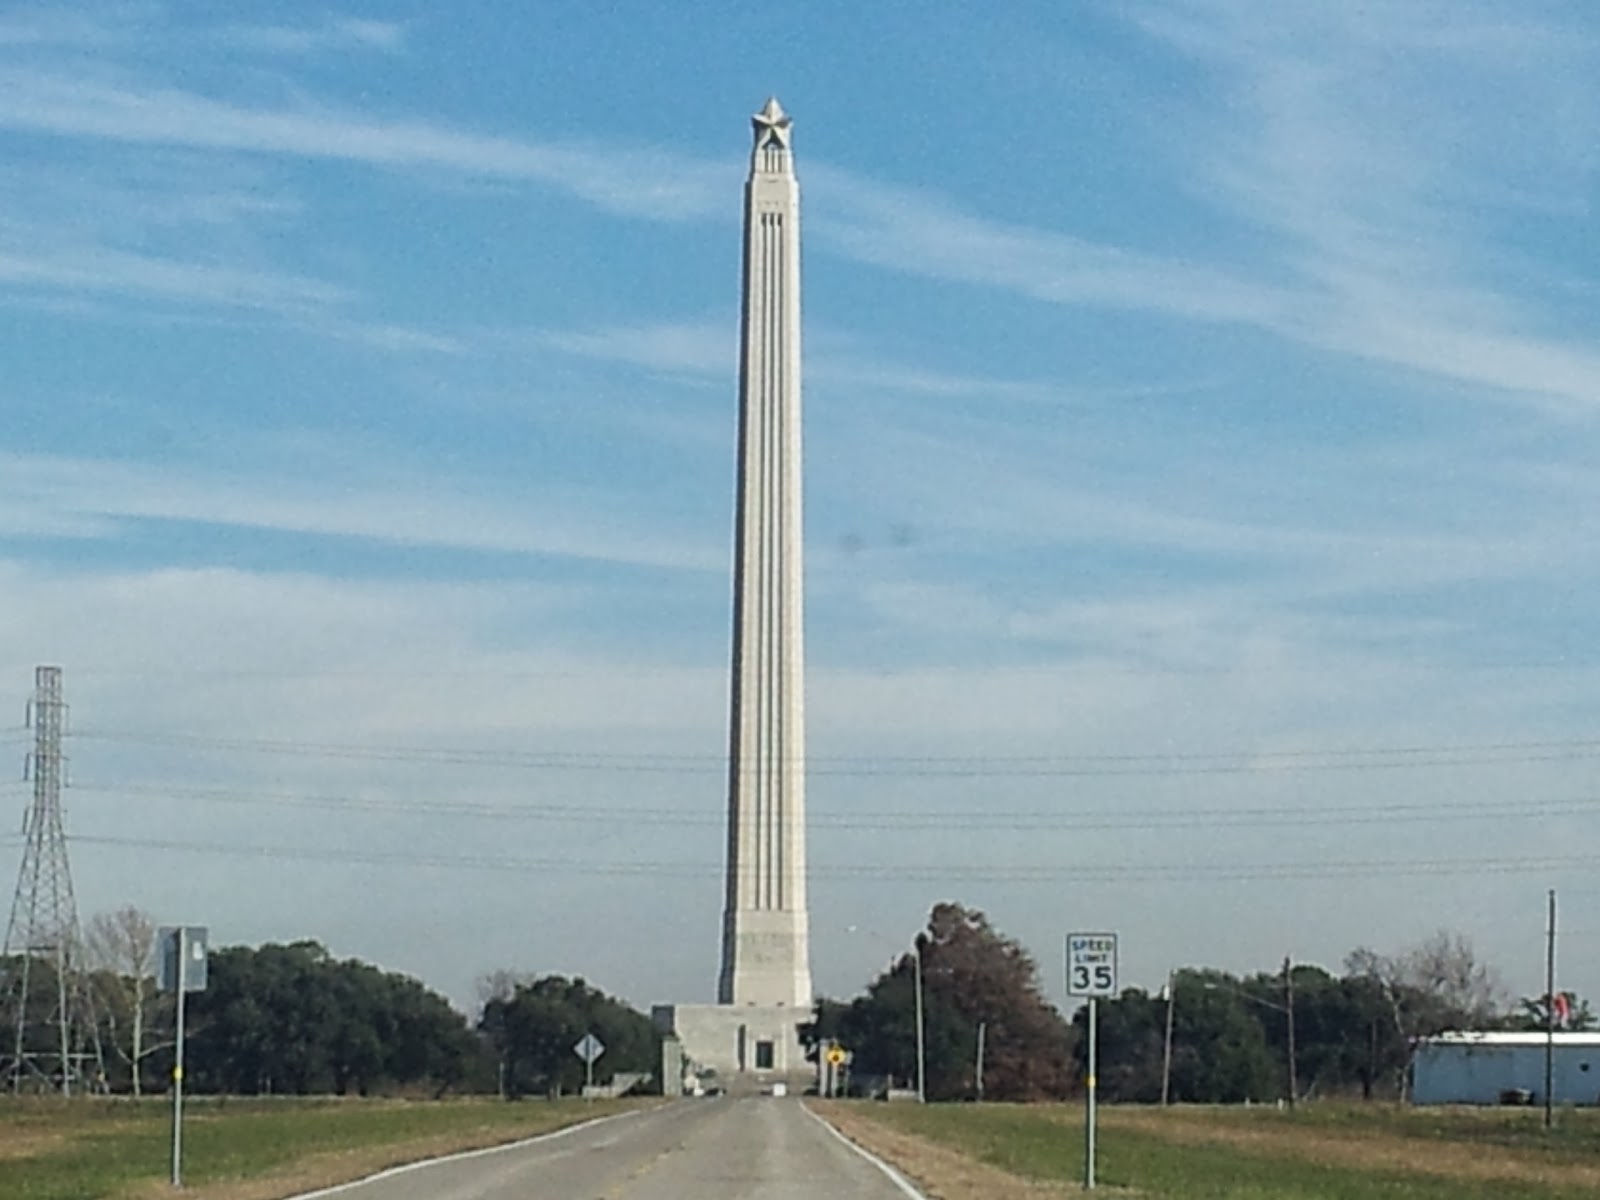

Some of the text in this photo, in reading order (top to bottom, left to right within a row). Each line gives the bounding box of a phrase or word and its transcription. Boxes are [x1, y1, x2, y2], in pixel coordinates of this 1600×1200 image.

[1072, 939, 1113, 951] SPEED
[1075, 953, 1107, 963] LIMIT
[1073, 966, 1111, 989] 35
